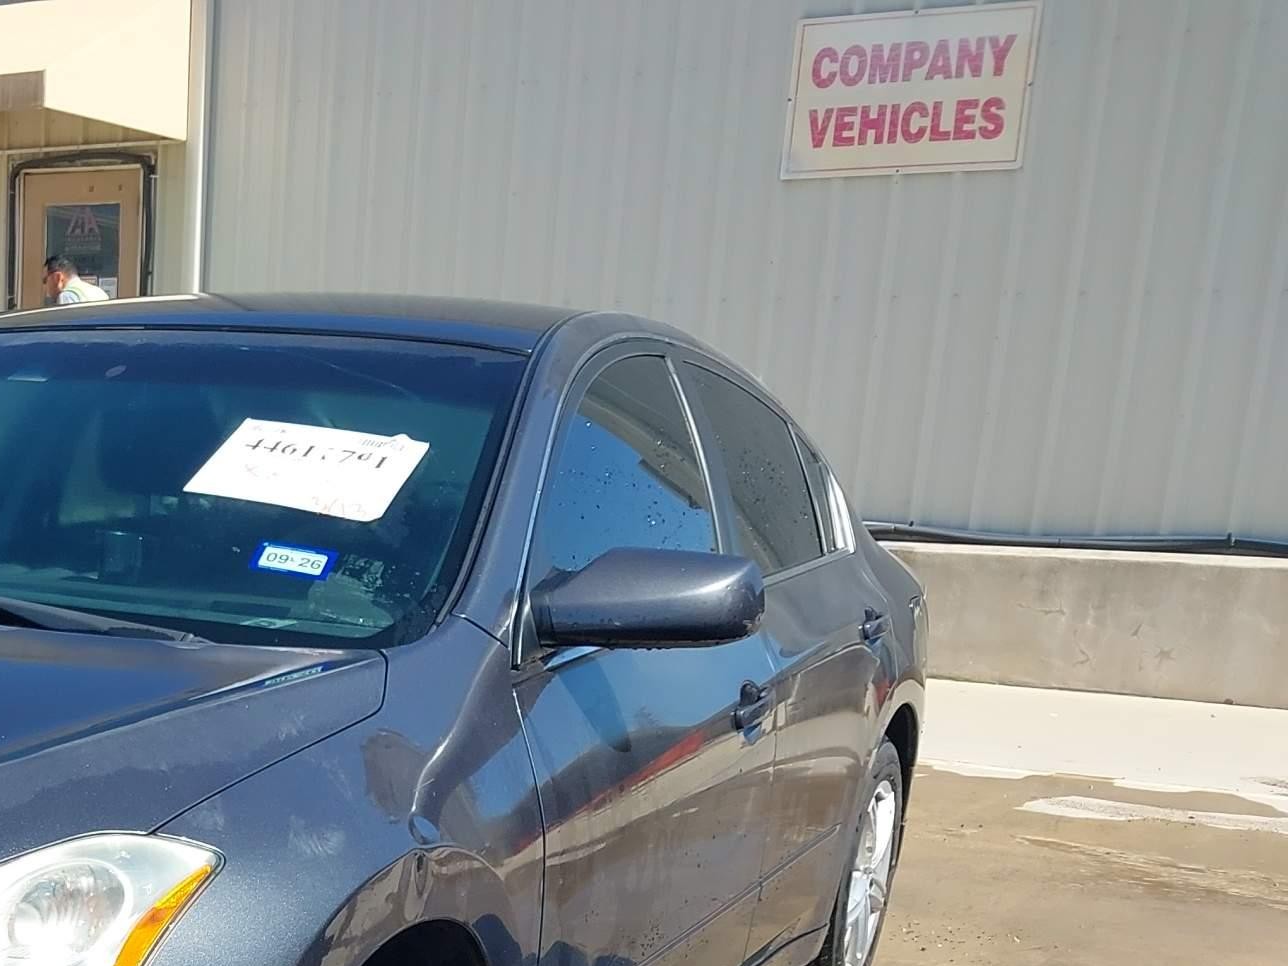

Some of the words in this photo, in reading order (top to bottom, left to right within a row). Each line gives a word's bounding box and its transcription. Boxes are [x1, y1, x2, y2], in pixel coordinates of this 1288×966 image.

[811, 34, 1017, 89] COMPANY
[808, 97, 1006, 148] VEHICLES
[245, 438, 387, 469] 4461791
